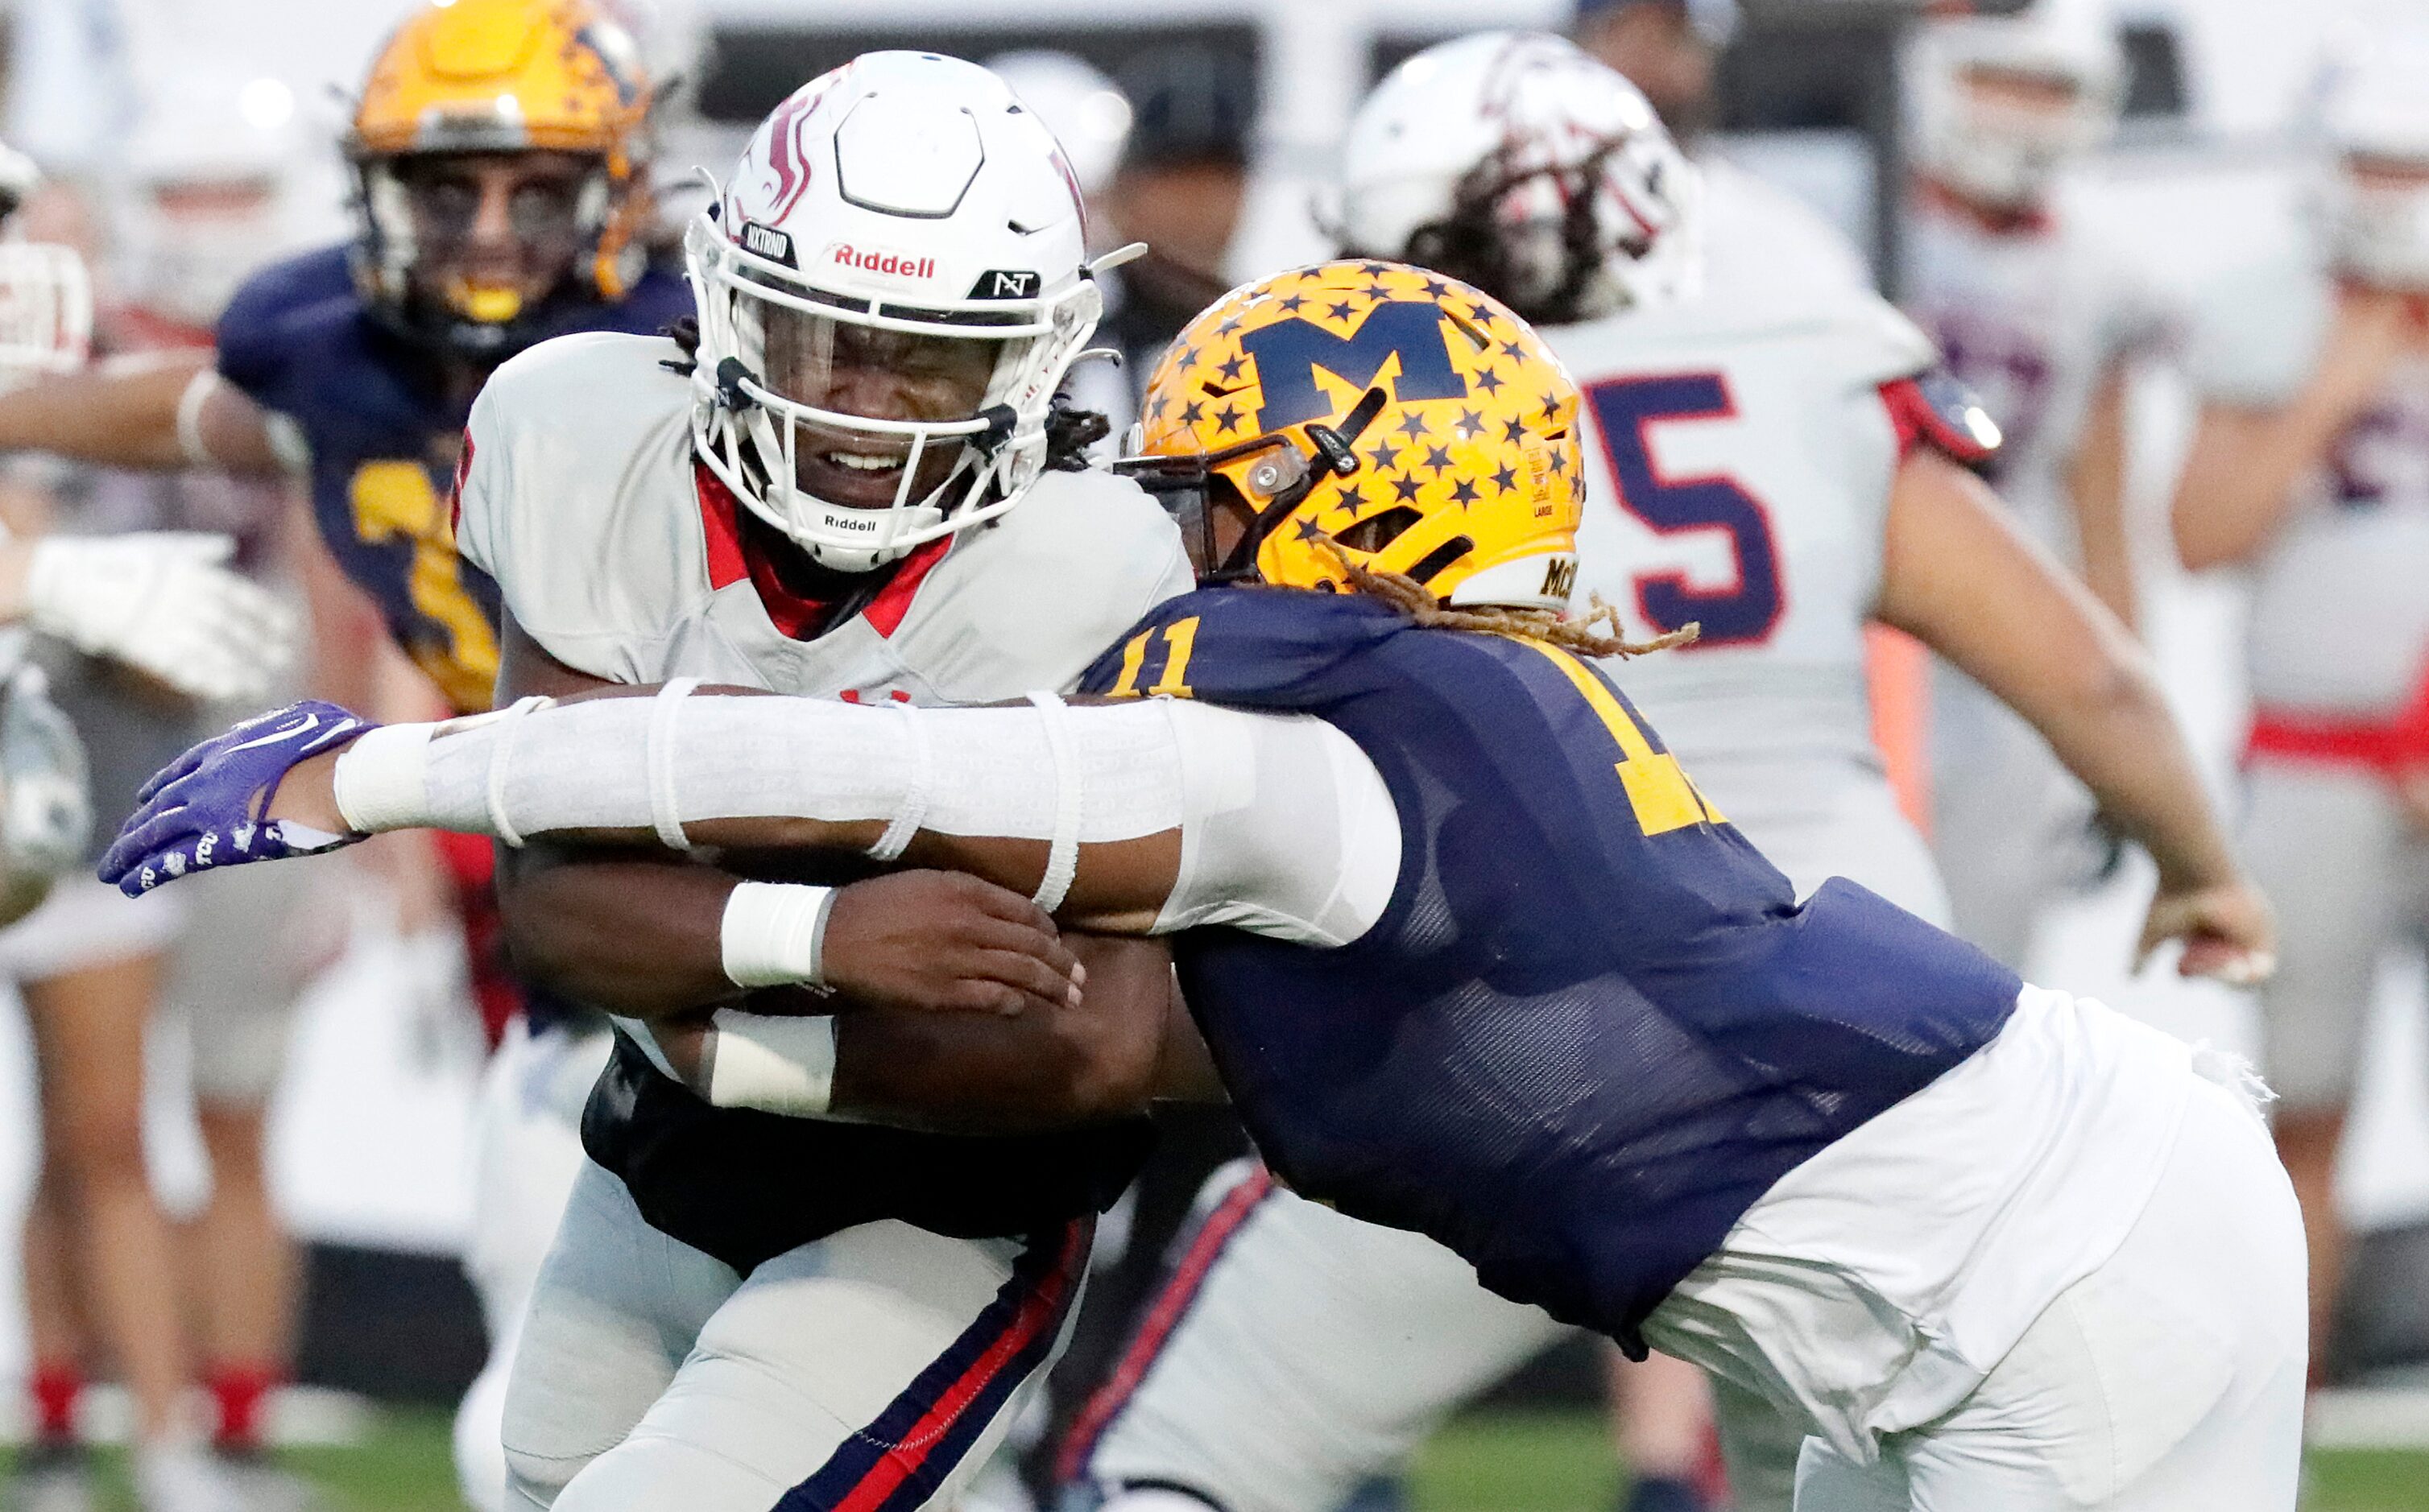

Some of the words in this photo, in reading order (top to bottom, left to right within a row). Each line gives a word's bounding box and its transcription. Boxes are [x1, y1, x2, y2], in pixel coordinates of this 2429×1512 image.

[747, 225, 788, 258] NXTRND
[834, 244, 936, 279] Riddell
[1241, 300, 1467, 434] M
[825, 514, 876, 531] Riddell
[1104, 616, 1200, 698] 11
[195, 830, 219, 865] TCU
[140, 866, 156, 889] CU
